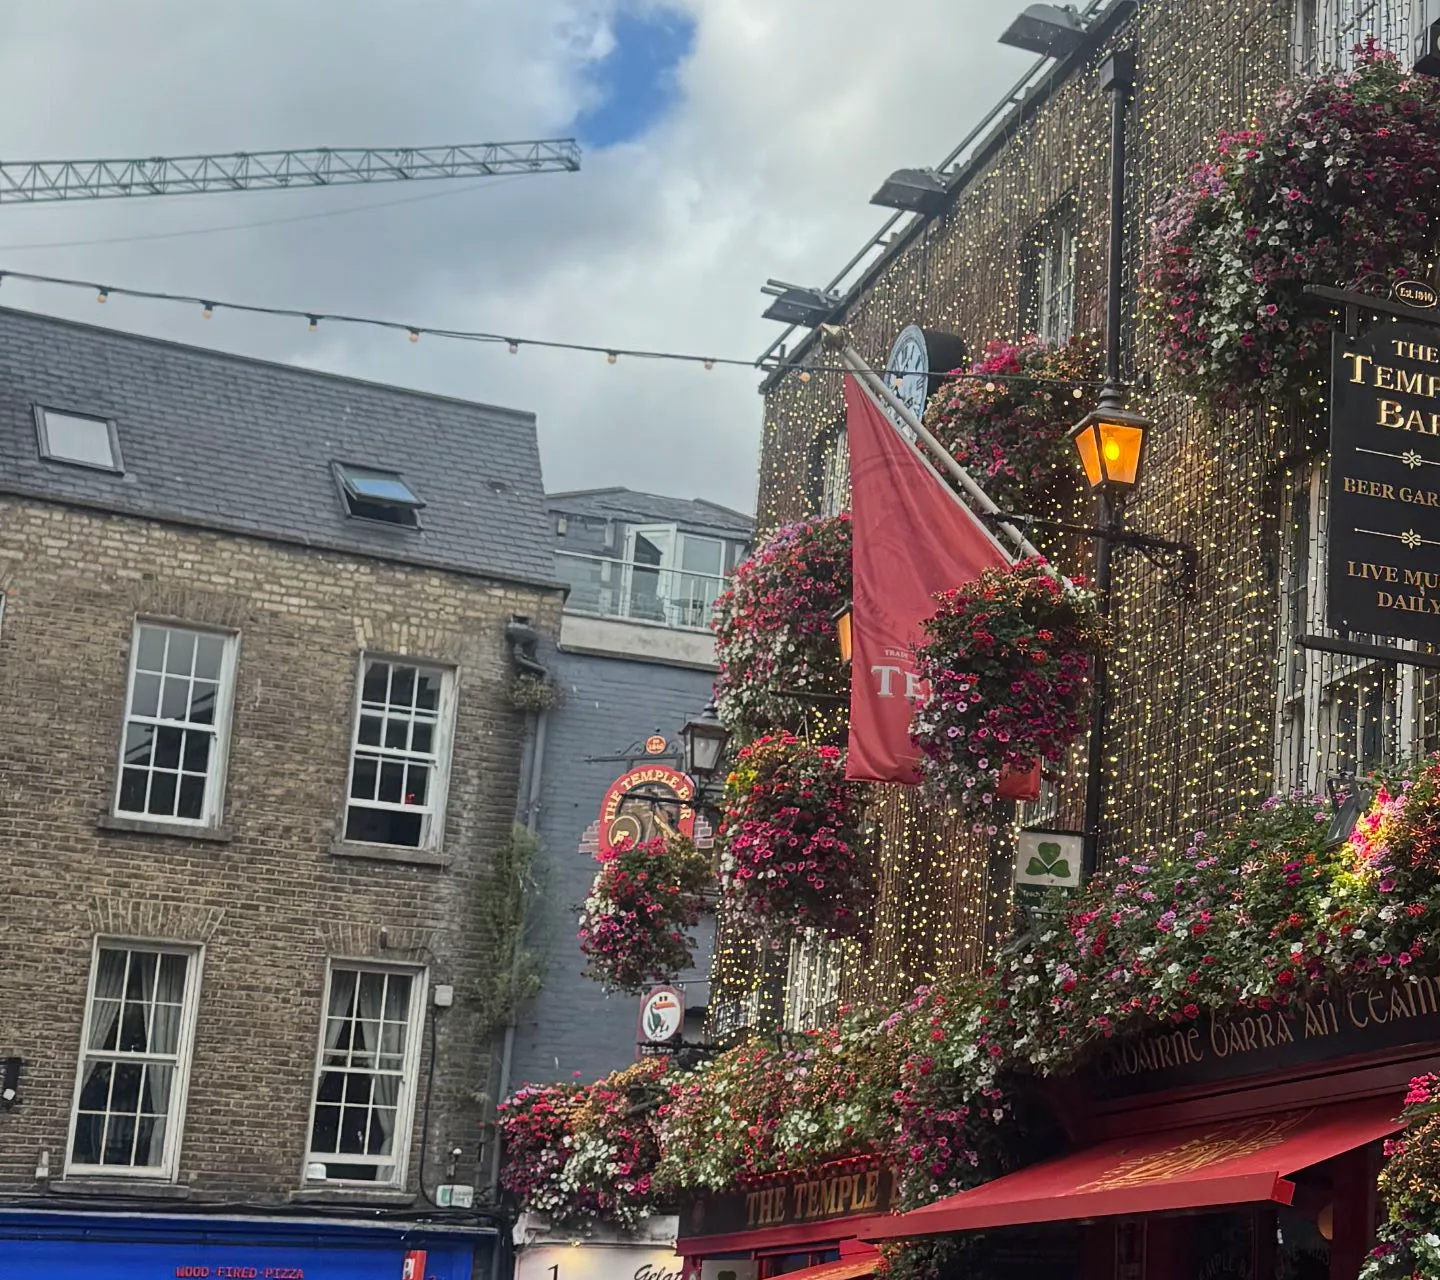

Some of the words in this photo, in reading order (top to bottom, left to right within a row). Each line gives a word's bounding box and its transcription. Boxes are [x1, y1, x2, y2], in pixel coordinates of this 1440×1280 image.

[1391, 339, 1440, 363] THE
[1343, 477, 1396, 501] BEER
[1347, 560, 1399, 585] LIVE
[604, 789, 623, 823] THE
[620, 769, 680, 790] TEMPLE
[746, 1186, 787, 1226] THE
[793, 1169, 880, 1220] TEMPLE
